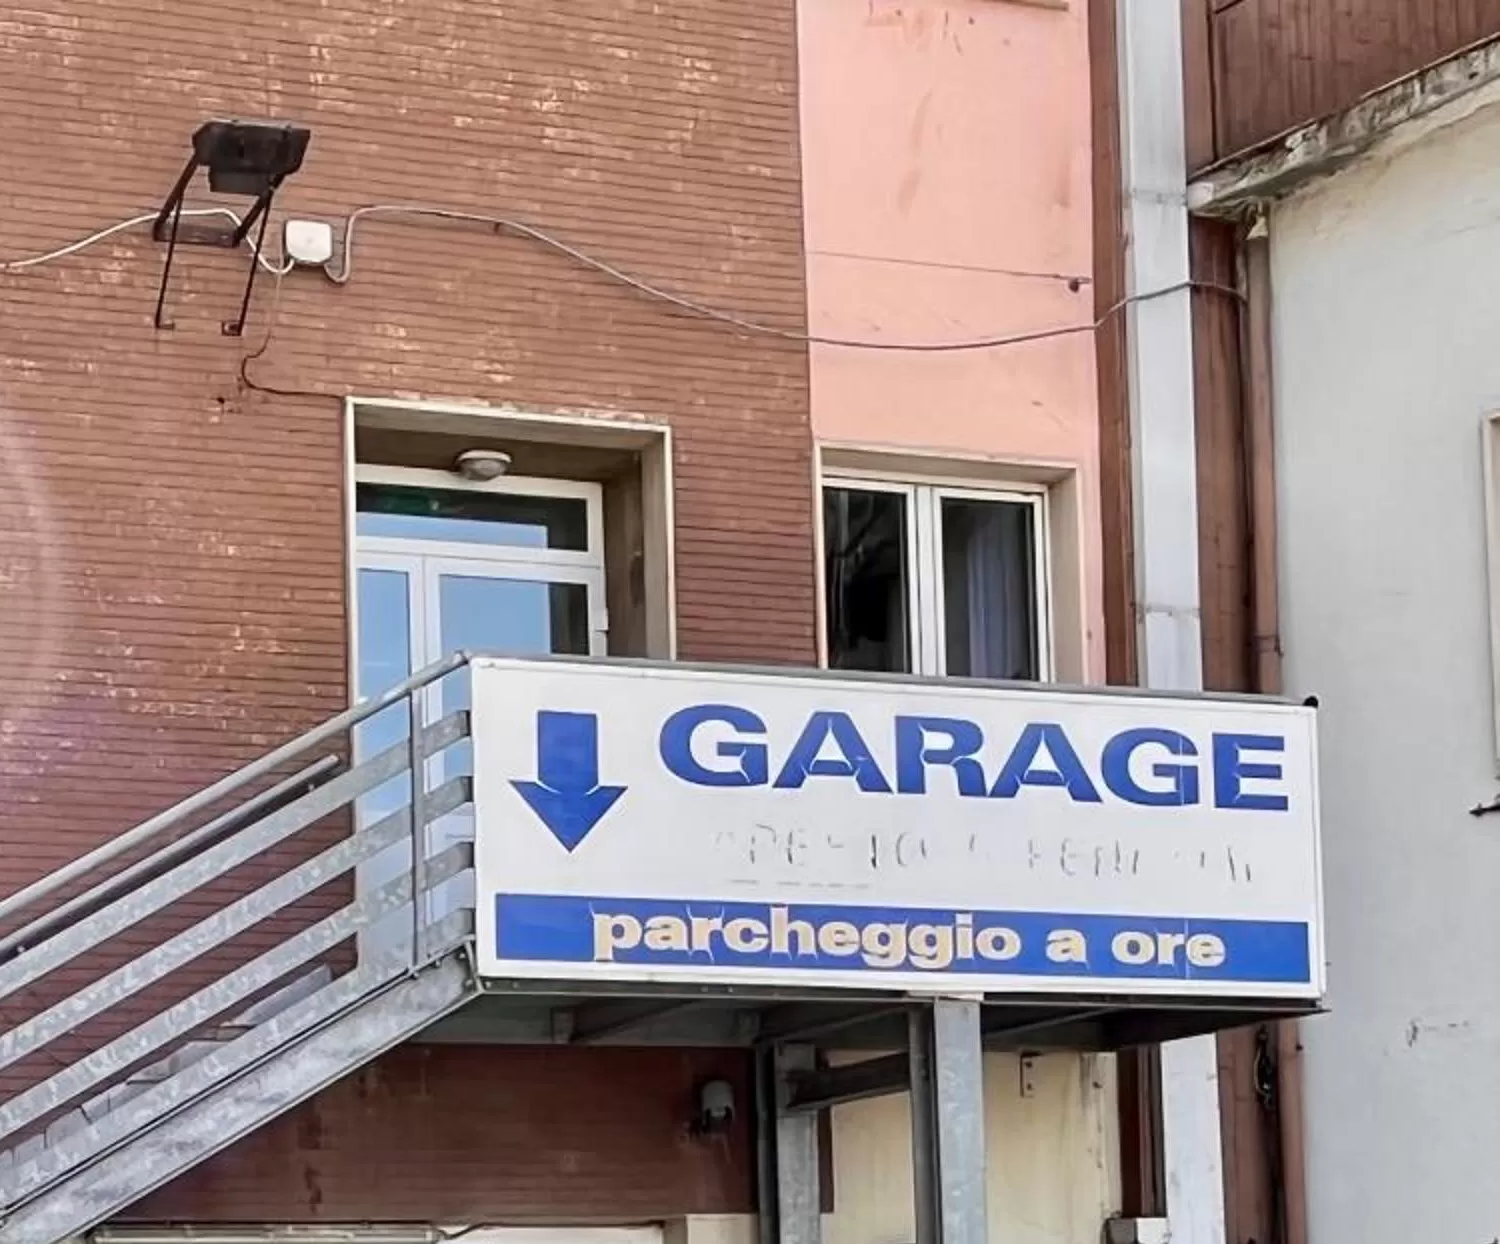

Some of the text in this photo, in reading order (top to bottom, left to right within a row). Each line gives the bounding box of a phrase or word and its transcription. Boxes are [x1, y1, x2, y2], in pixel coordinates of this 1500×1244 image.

[657, 703, 1290, 812] GARAGE
[594, 904, 1226, 970] parcheggio a ore
